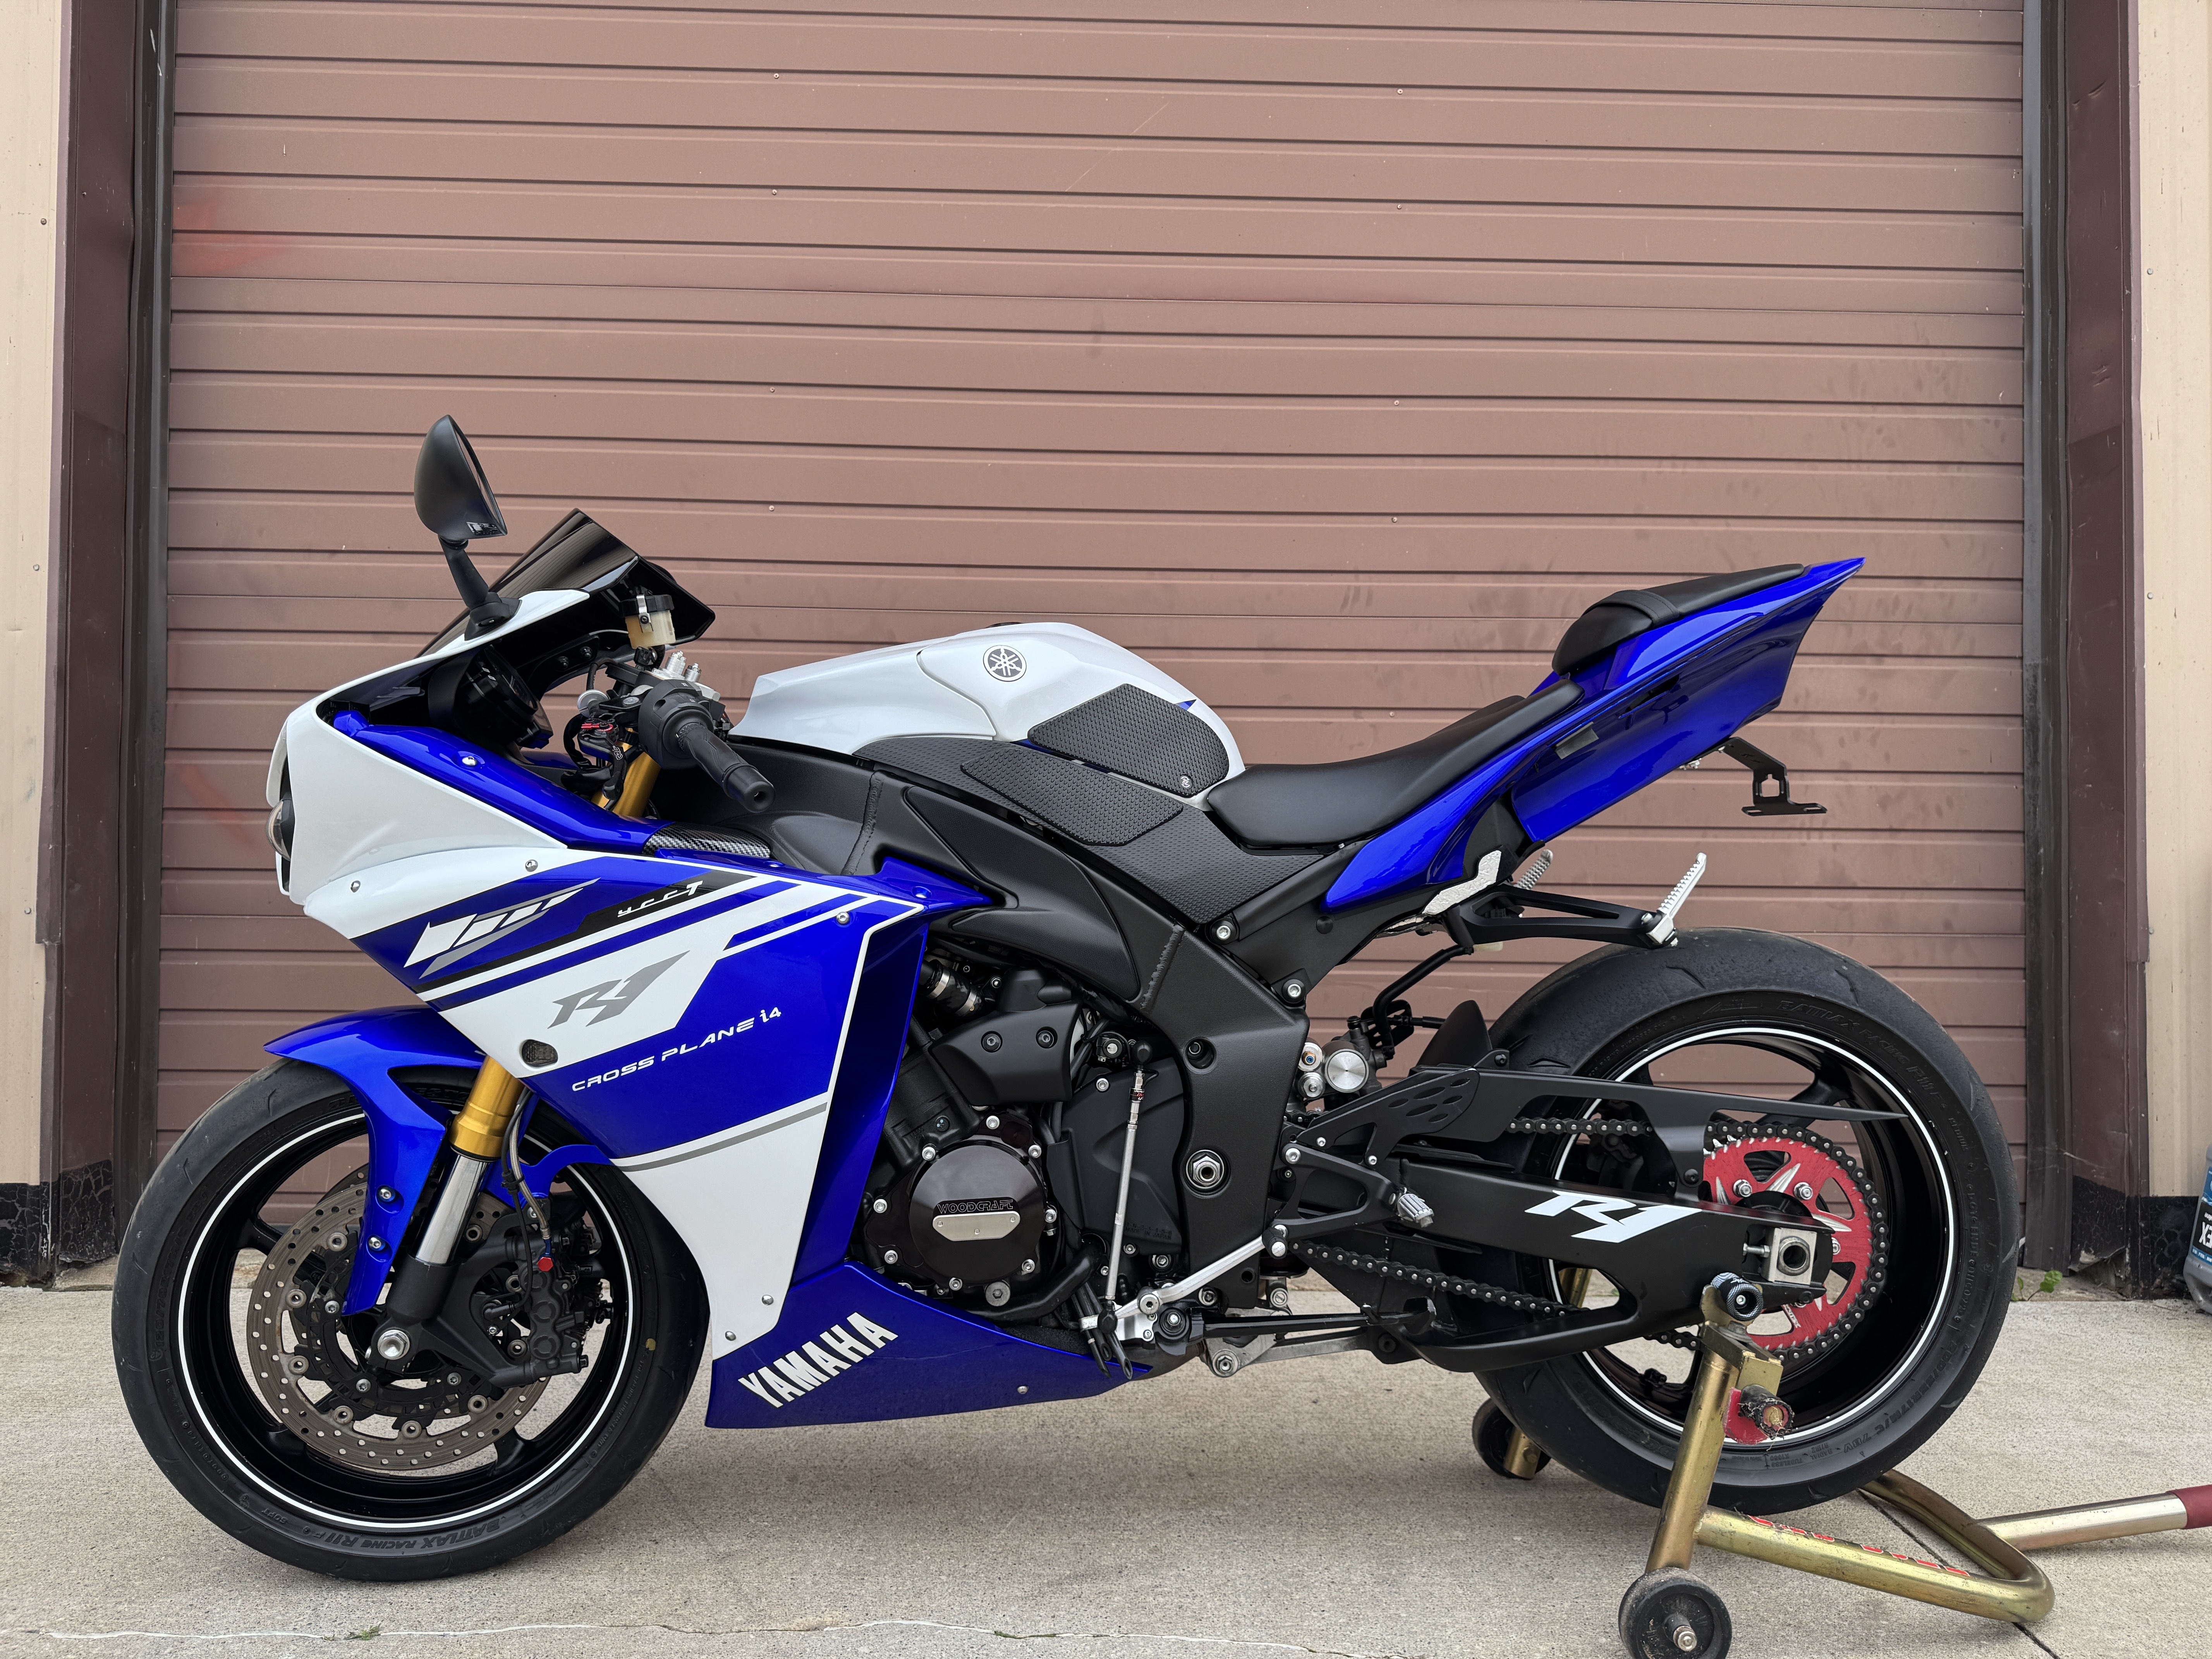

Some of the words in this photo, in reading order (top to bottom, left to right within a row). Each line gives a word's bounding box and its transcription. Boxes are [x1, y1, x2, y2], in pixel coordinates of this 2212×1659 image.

[547, 950, 690, 1029] R1
[572, 1056, 654, 1091] CROSS
[661, 1017, 755, 1061] PLANE
[937, 1200, 1013, 1214] WOODCRAFT
[1524, 1190, 1703, 1243] R1
[738, 1312, 898, 1408] YAMAHA
[1841, 1432, 1872, 1453] 78V
[324, 1531, 359, 1547] R11
[360, 1539, 417, 1549] RACING
[419, 1518, 503, 1548] BATTLAX
